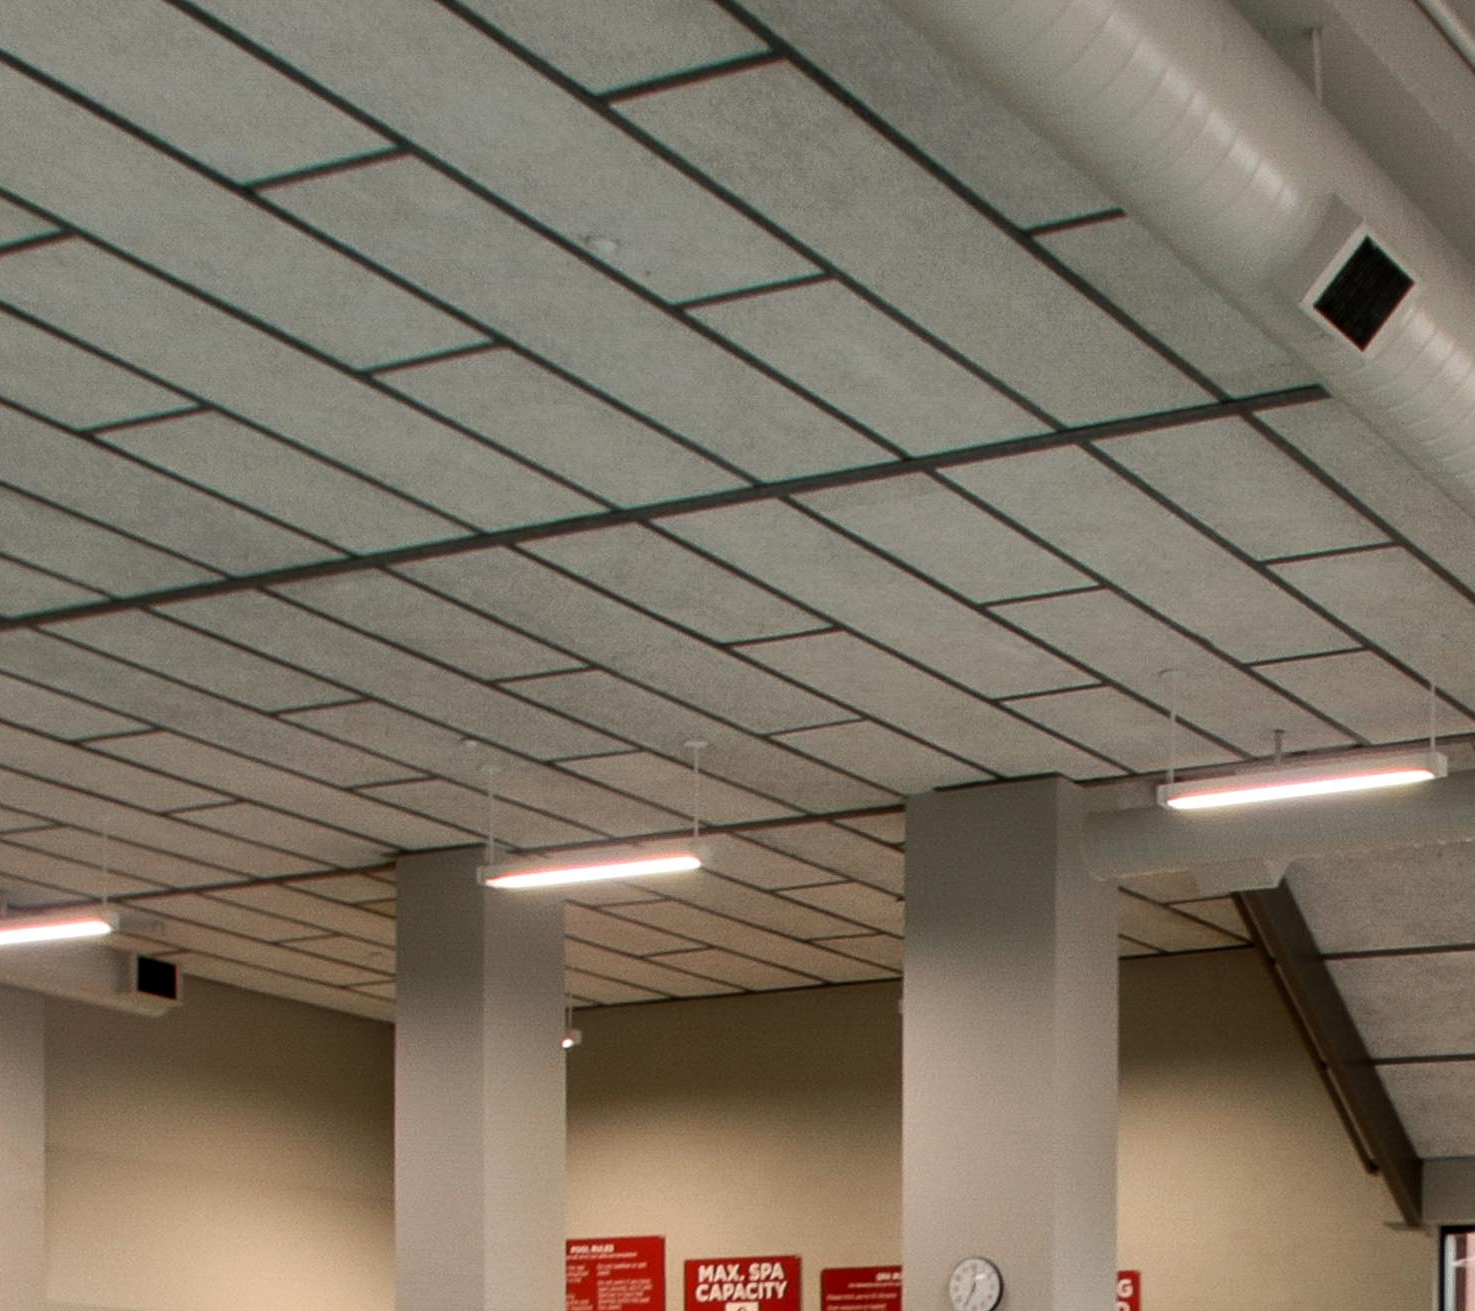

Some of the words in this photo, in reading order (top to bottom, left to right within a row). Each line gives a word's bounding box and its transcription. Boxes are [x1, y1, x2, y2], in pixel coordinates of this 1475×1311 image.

[698, 1264, 745, 1283] MAX.
[749, 1262, 785, 1281] SPA
[695, 1281, 788, 1302] CAPACITY
